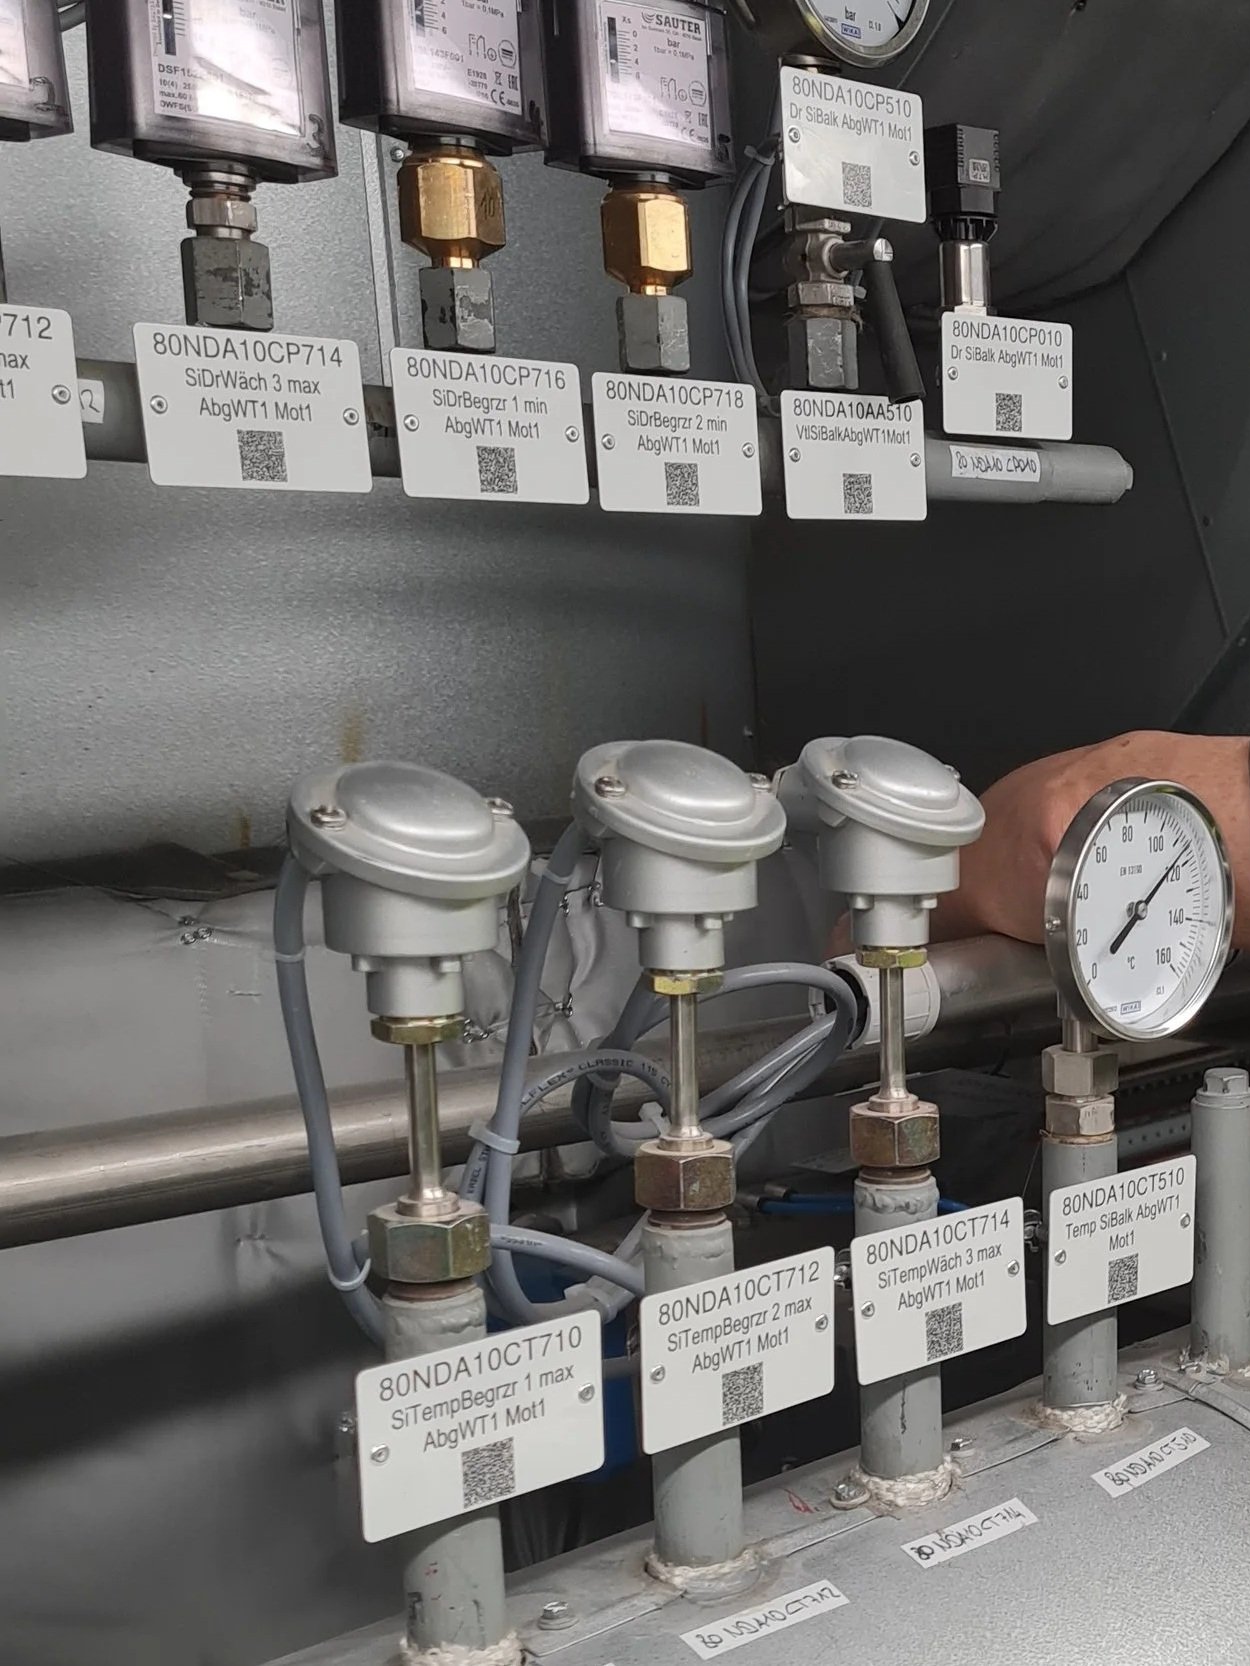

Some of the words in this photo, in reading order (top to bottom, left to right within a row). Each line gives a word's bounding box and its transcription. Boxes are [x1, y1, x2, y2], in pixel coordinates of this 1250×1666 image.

[655, 14, 702, 34] SAUTER
[844, 6, 856, 21] bar
[667, 38, 681, 48] bar
[793, 76, 912, 118] 80NDA10CP510
[789, 103, 802, 120] Dr
[805, 106, 839, 126] SiBalk
[841, 113, 885, 136] AbgWT1
[888, 124, 912, 142] Mot1
[0, 312, 53, 340] 712
[952, 320, 1062, 347] 80NDA10CP010
[152, 332, 343, 367] 80NDA10CP714
[951, 344, 964, 360] Dr
[965, 345, 996, 363] SiBalk
[998, 348, 1038, 367] AbgWT1
[1041, 353, 1064, 369] Mot1
[184, 367, 268, 393] SiDrWäch
[272, 377, 282, 392] 3
[288, 379, 321, 396] max
[407, 357, 567, 390] 80NDA10CP716
[432, 388, 508, 415] SiDrBegrzr
[512, 397, 520, 413] 1
[524, 397, 549, 415] min
[605, 380, 745, 409] 80NDA10CP718
[199, 398, 268, 422] AbgWT1
[275, 402, 313, 422] Mot1
[627, 409, 693, 433] SiDrBegrzr
[695, 415, 705, 431] 2
[706, 416, 728, 432] min
[793, 397, 913, 423] 80NDA10AA510
[444, 416, 503, 441] AbgWT1
[508, 418, 540, 439] Mot1
[637, 434, 689, 457] AbgWT1
[692, 435, 721, 456] Mot1
[1122, 825, 1134, 843] 80
[1149, 835, 1164, 852] 100
[1096, 846, 1108, 863] 60
[1165, 865, 1181, 882] 120
[1077, 884, 1089, 900] 40
[1169, 910, 1184, 926] 140
[1076, 929, 1088, 946] 20
[1156, 946, 1171, 965] 160
[1092, 963, 1097, 979] 0
[577, 1058, 633, 1072] CLASSIC
[1063, 1167, 1185, 1216] 80NDA10CT510
[1066, 1219, 1097, 1240] Temp
[1099, 1207, 1134, 1231] SiBalk
[1136, 1194, 1180, 1221] AbgWT1
[866, 1208, 1010, 1265] 80NDA10CT714
[1109, 1229, 1135, 1251] Mot1
[878, 1255, 963, 1290] SiTempWäch
[966, 1251, 975, 1267] 3
[976, 1242, 1003, 1263] max
[658, 1260, 820, 1326] 80NDA10CT712
[898, 1281, 951, 1311] AbgWT1
[956, 1271, 986, 1293] Mot1
[667, 1309, 769, 1353] SiTempBegrzr
[771, 1302, 781, 1321] 2
[783, 1296, 812, 1318] max
[379, 1325, 582, 1402] 80NDA10CT710
[692, 1339, 752, 1374] AbgWT1
[757, 1327, 790, 1352] Mot1
[391, 1380, 519, 1431] SiTempBegrzr
[524, 1372, 532, 1392] 1
[539, 1364, 575, 1388] max
[423, 1416, 498, 1453] AbgWT1
[506, 1398, 546, 1427] Mot1
